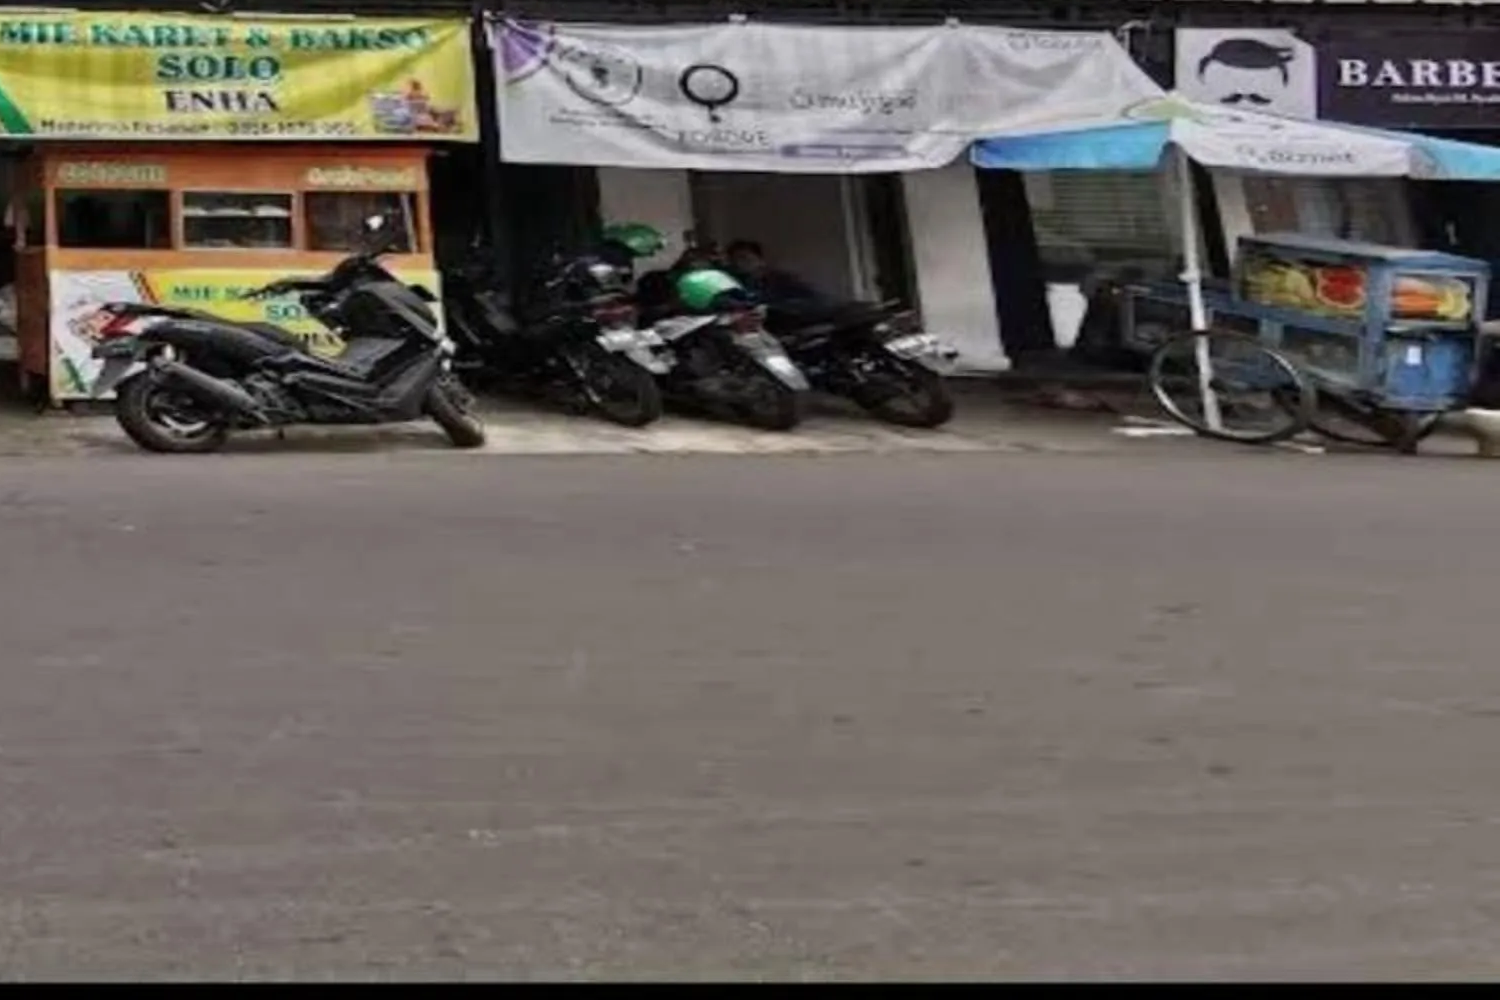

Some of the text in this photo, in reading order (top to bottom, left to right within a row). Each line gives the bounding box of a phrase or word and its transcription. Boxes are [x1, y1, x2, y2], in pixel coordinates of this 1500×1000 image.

[0, 21, 73, 45] MIE
[157, 54, 281, 81] SOLO
[164, 90, 280, 112] ENHA
